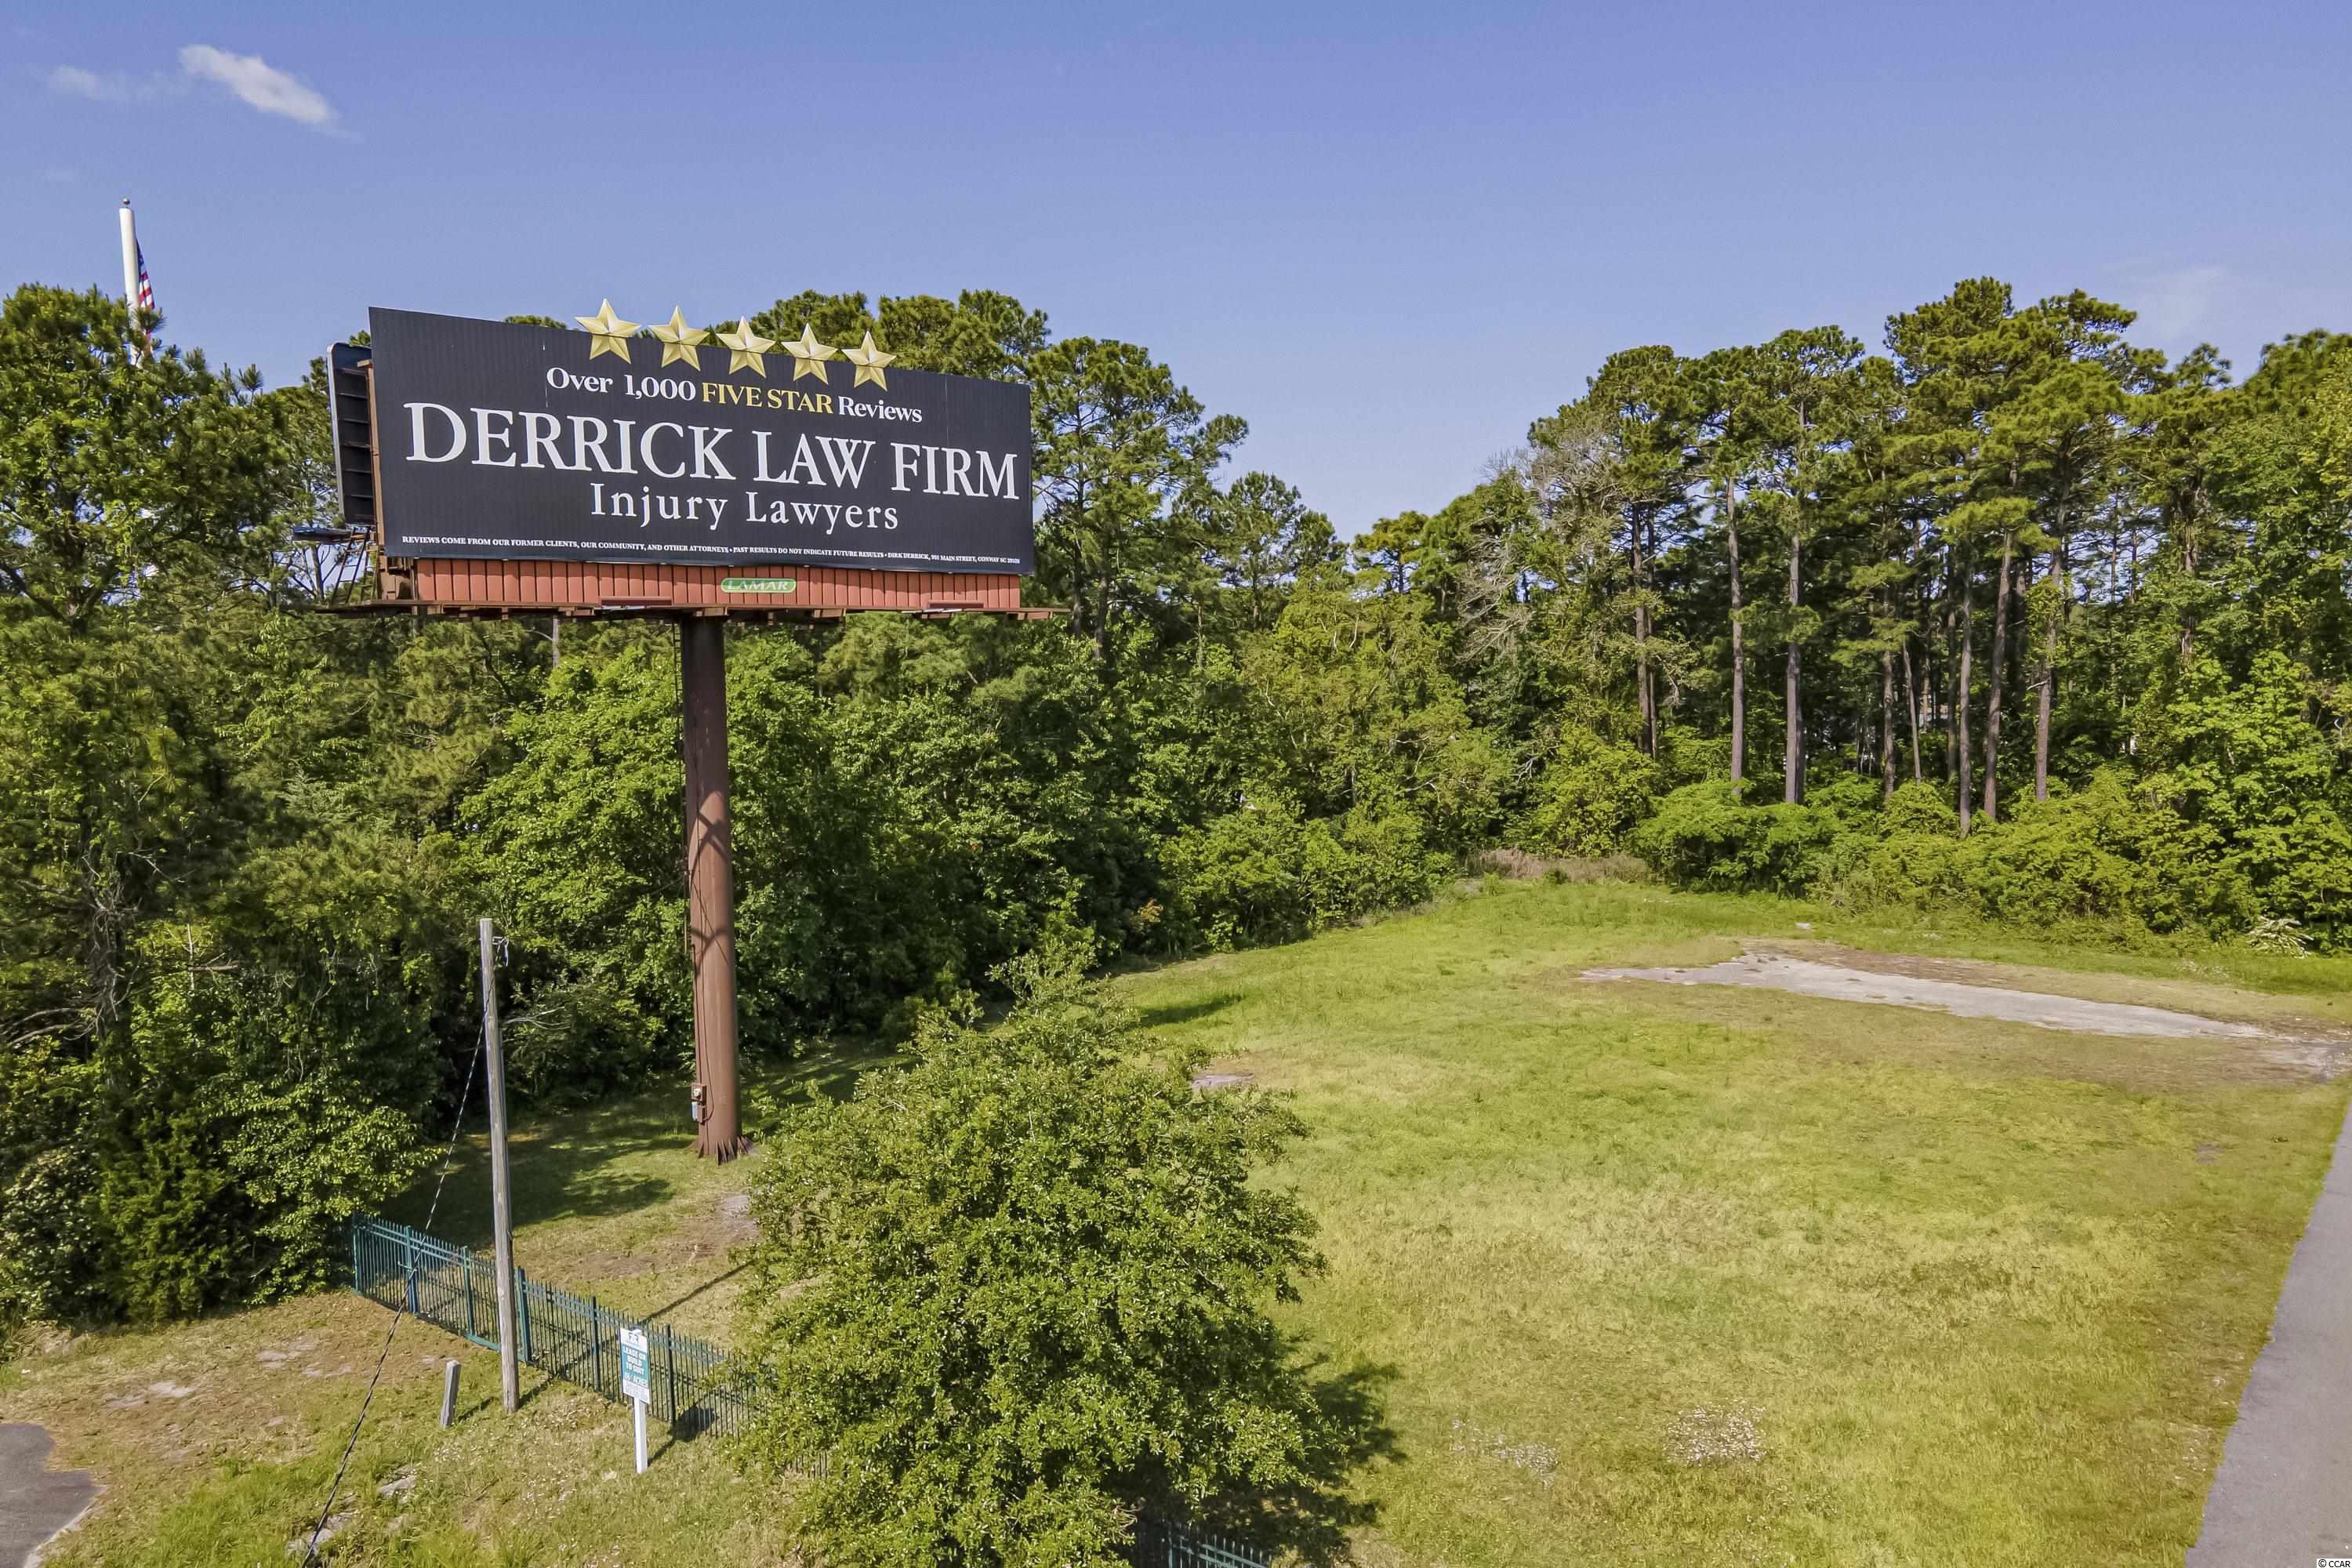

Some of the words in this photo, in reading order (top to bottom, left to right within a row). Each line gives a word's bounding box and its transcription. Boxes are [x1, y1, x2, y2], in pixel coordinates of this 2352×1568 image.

[546, 367, 614, 394] Over
[624, 374, 696, 401] 1,000
[702, 382, 763, 407] FIVE
[767, 388, 834, 414] STAR
[838, 395, 923, 423] Reviews
[403, 402, 737, 481] DERRICK
[751, 430, 877, 489] LAW
[890, 442, 1020, 500] FIRM
[590, 482, 728, 531] Injury
[746, 491, 898, 535] Lawyers
[402, 535, 440, 544] REVIEWS
[441, 536, 466, 545] COME
[546, 539, 580, 549] CLIENTS,
[597, 542, 647, 551] COMMUNITY,
[688, 545, 729, 554] ATTORNEYS
[727, 579, 788, 591] LAMAR
